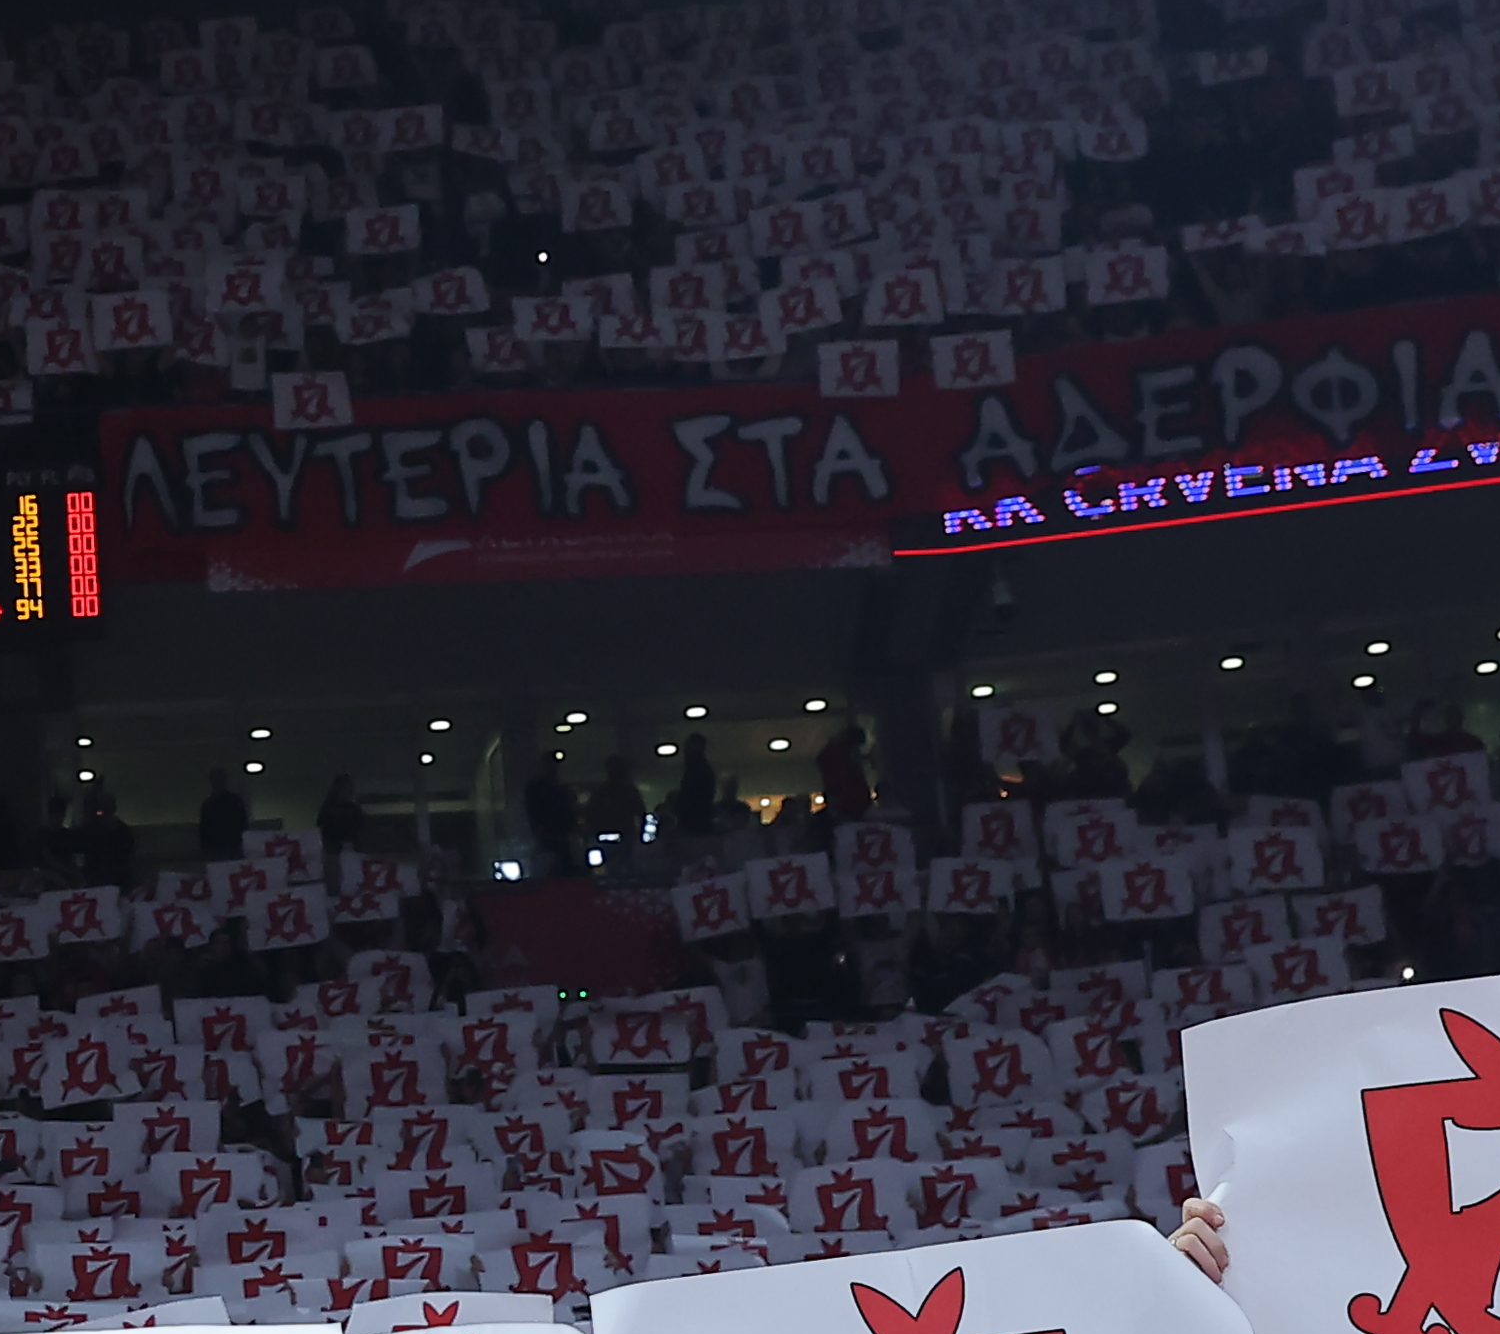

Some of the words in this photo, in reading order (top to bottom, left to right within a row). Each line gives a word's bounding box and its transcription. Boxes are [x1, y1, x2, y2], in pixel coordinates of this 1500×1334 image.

[122, 417, 632, 530] ΛΕΥΤΕΡΙΑ
[675, 414, 891, 510] ΣΤΑ
[18, 495, 37, 515] 16
[67, 492, 92, 513] 00
[12, 516, 38, 536] 22
[68, 513, 93, 534] 00
[13, 536, 40, 556] 25
[69, 534, 94, 555] 00
[14, 556, 41, 578] 33
[71, 555, 96, 575] 00
[16, 578, 41, 597] 77
[72, 575, 97, 596] 00
[17, 599, 43, 620] 94
[73, 596, 98, 617] 00
